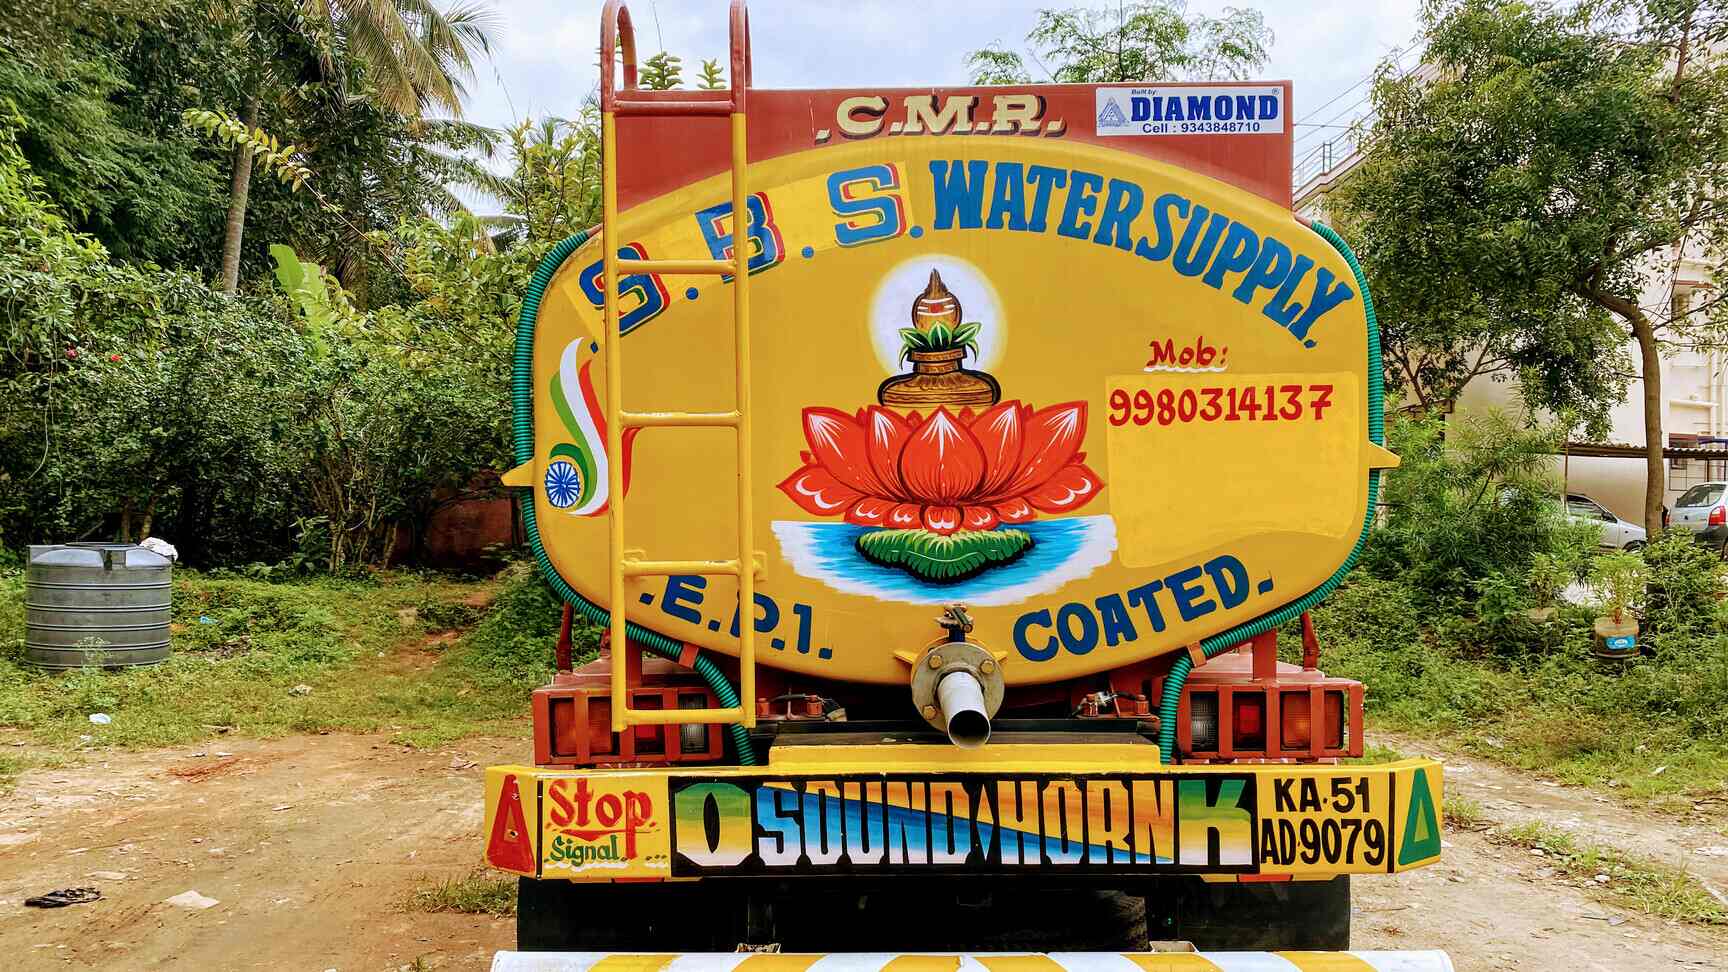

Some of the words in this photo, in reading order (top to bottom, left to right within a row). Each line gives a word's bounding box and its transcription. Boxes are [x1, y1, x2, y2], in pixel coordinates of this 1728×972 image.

[1131, 95, 1278, 121] DIAMOND
[1142, 123, 1168, 133] Cell
[1181, 122, 1260, 133] 9343848710
[1146, 336, 1228, 367] Mob:
[1109, 384, 1333, 427] 9980314137
[756, 781, 971, 865] SOUND
[997, 780, 1174, 865] HORN
